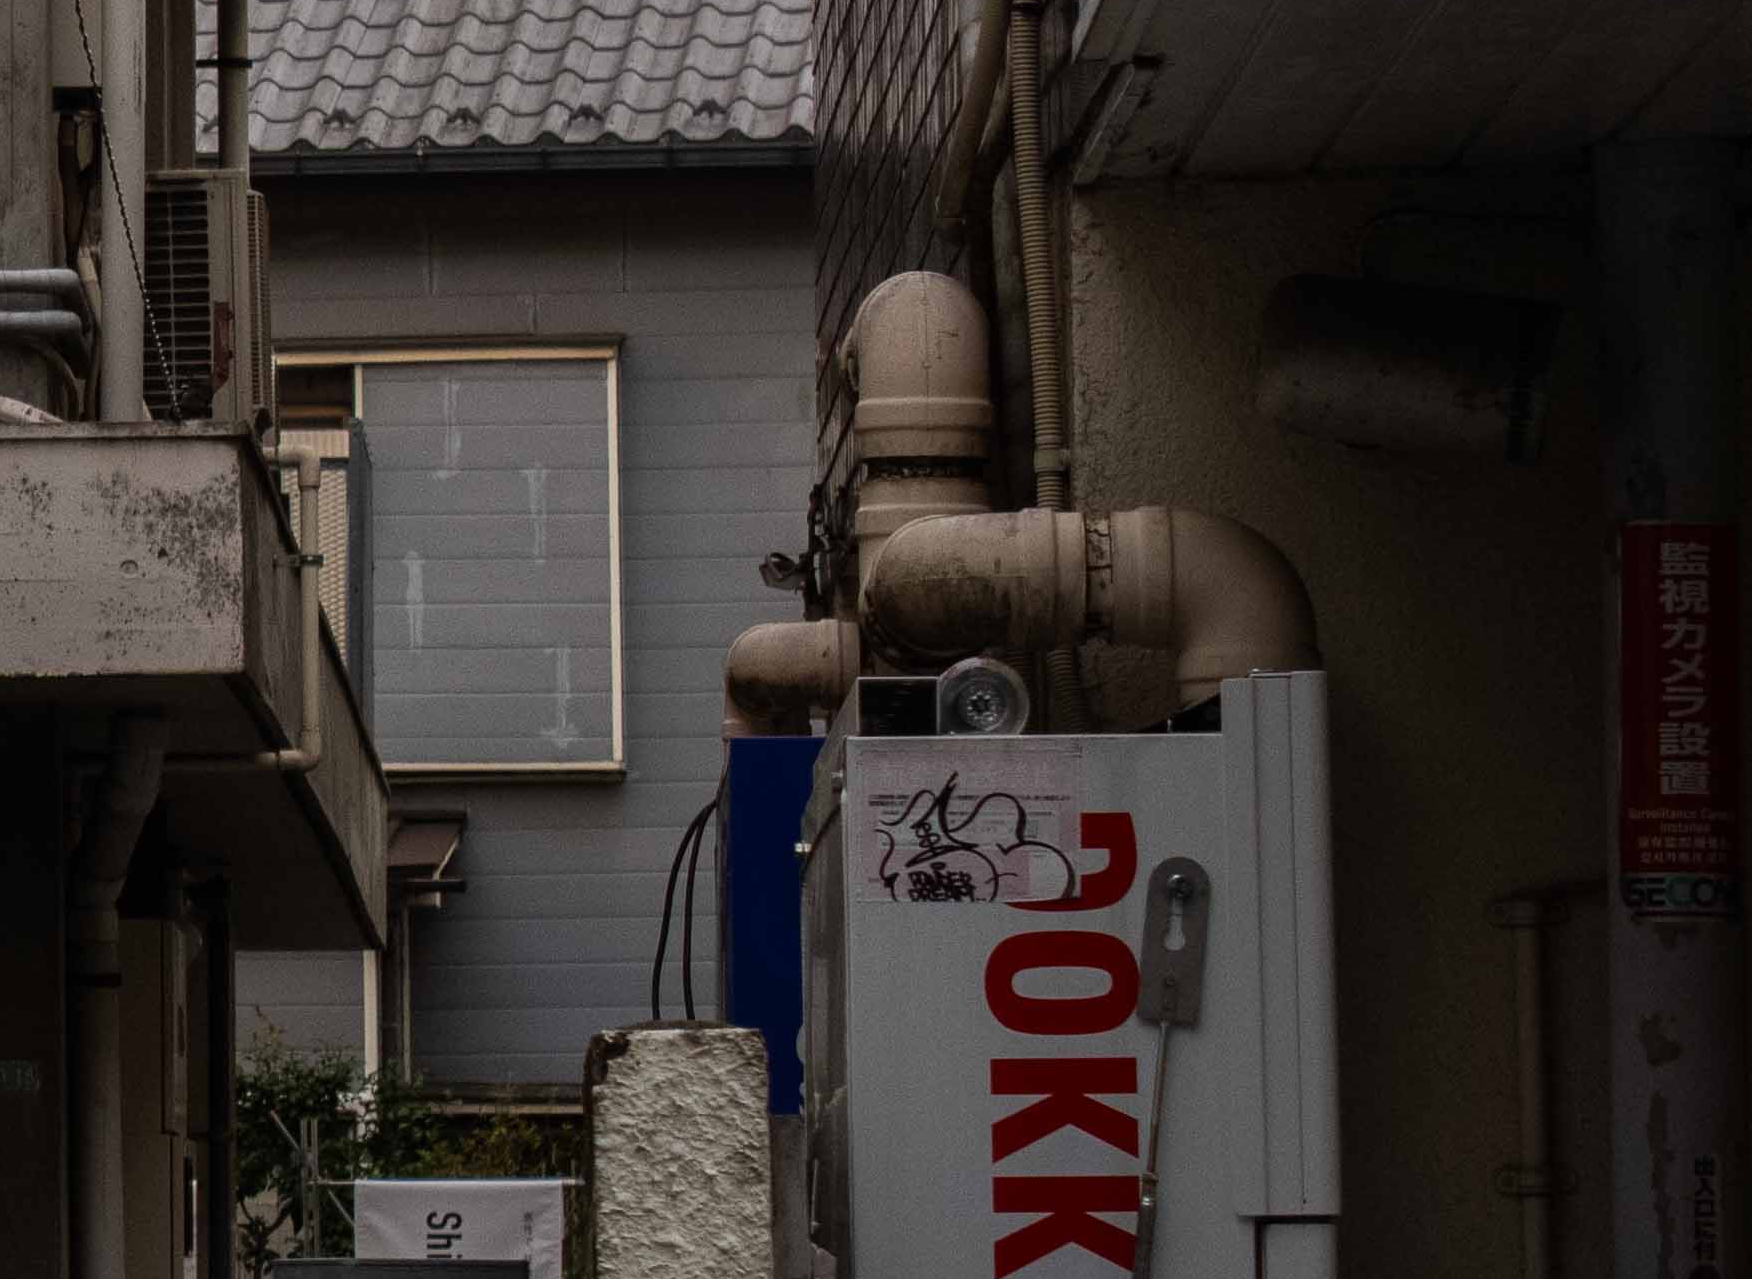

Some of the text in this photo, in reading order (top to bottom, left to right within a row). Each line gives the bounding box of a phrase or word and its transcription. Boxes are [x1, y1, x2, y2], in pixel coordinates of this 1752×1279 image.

[1658, 539, 1712, 796] 監視カメラ設置
